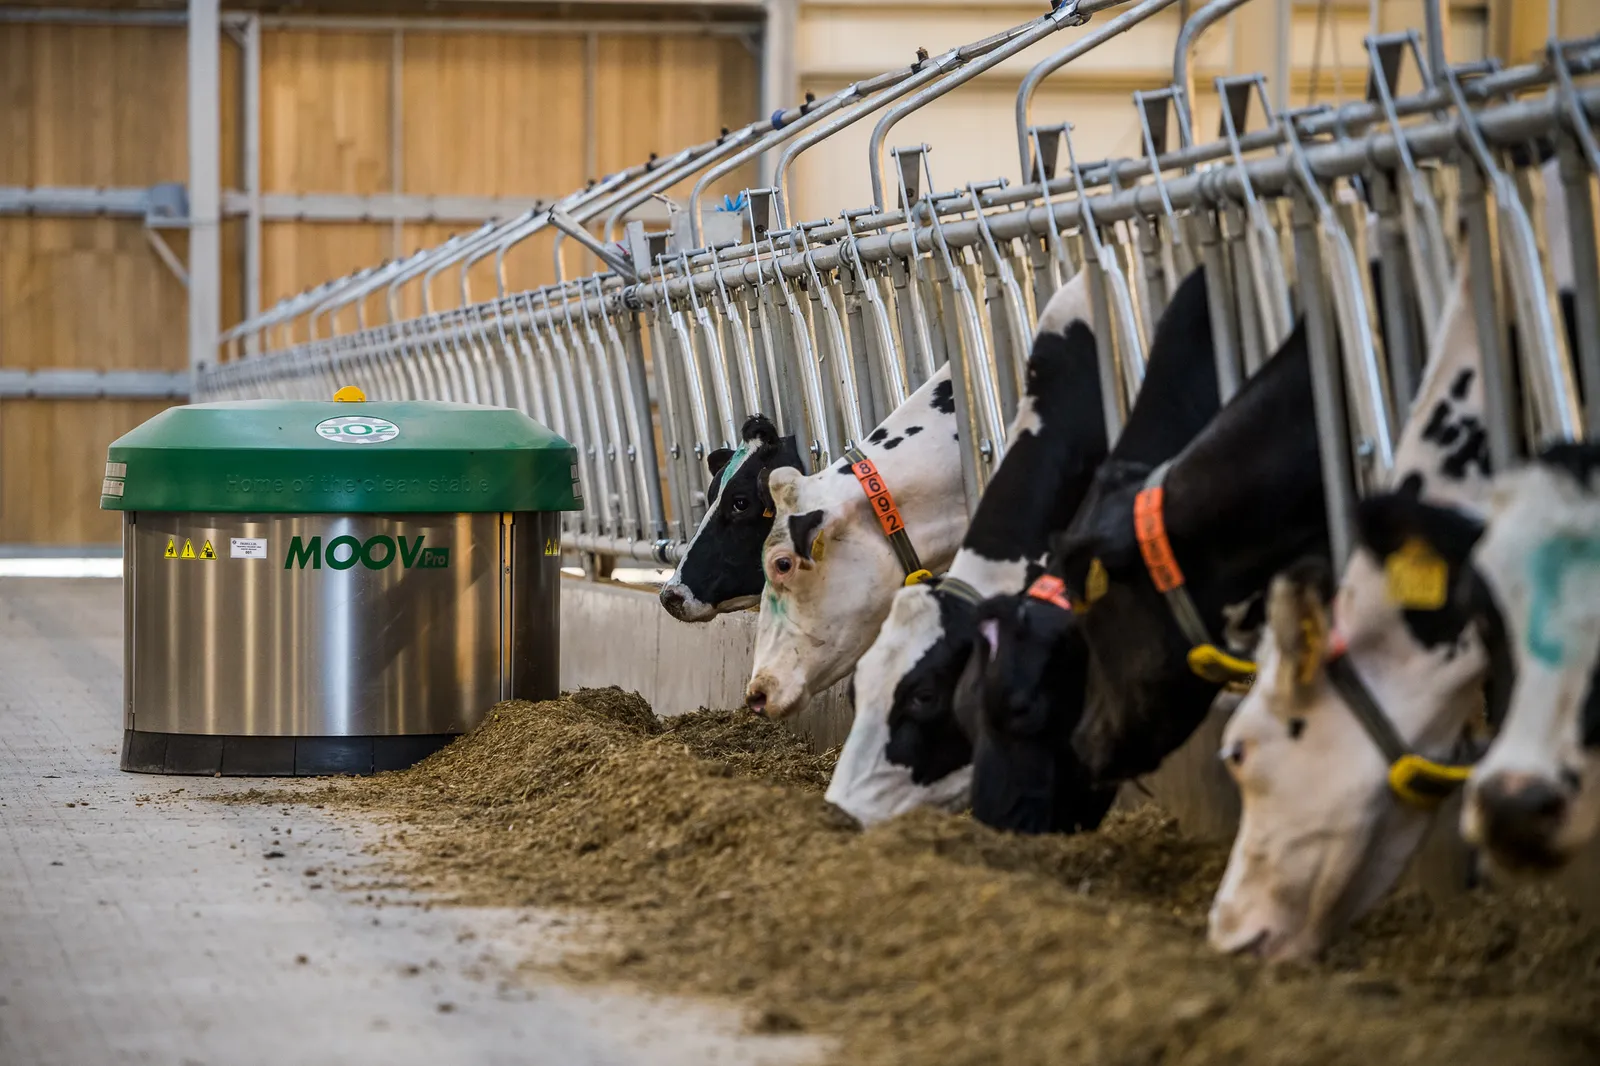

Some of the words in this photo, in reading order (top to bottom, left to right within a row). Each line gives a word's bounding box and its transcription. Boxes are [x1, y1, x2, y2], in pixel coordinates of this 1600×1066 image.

[320, 424, 396, 436] JOZ
[226, 474, 283, 493] Home
[292, 474, 314, 492] of
[320, 474, 356, 493] the
[363, 474, 420, 492] clean
[428, 474, 489, 492] stable
[859, 462, 900, 531] 8692
[284, 535, 425, 570] MOOV
[424, 551, 446, 566] Pro
